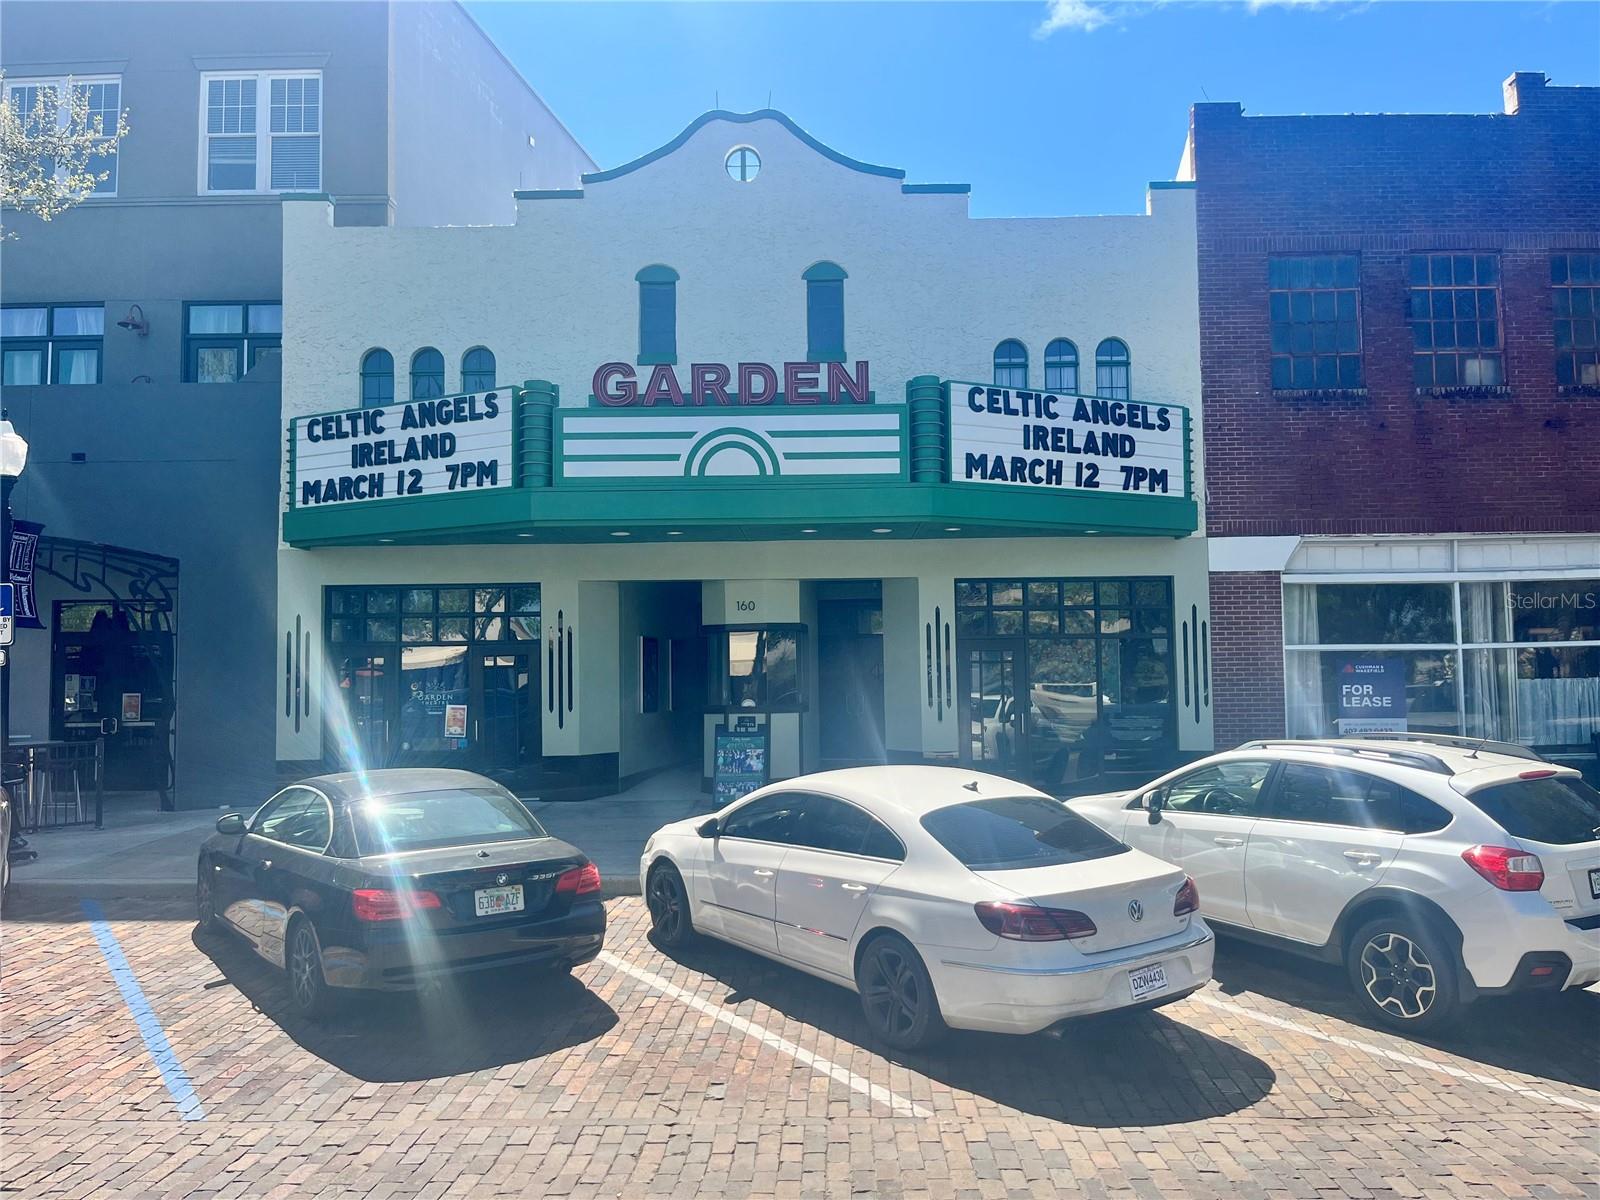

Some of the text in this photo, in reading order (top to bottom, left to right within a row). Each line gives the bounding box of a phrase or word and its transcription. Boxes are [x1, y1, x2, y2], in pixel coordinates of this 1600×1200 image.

[592, 361, 869, 407] GARDEN
[307, 392, 499, 443] CELTIC ANGELS
[968, 386, 1171, 432] CELTIC ANGELS
[351, 432, 456, 468] IRELAND
[1023, 424, 1136, 458] IRELAND
[302, 460, 498, 505] MARCH 12 7PM
[965, 452, 1169, 493] MARCH 12 7PM
[737, 600, 756, 611] 160
[1342, 684, 1373, 695] FOR
[1343, 696, 1392, 707] LEASE
